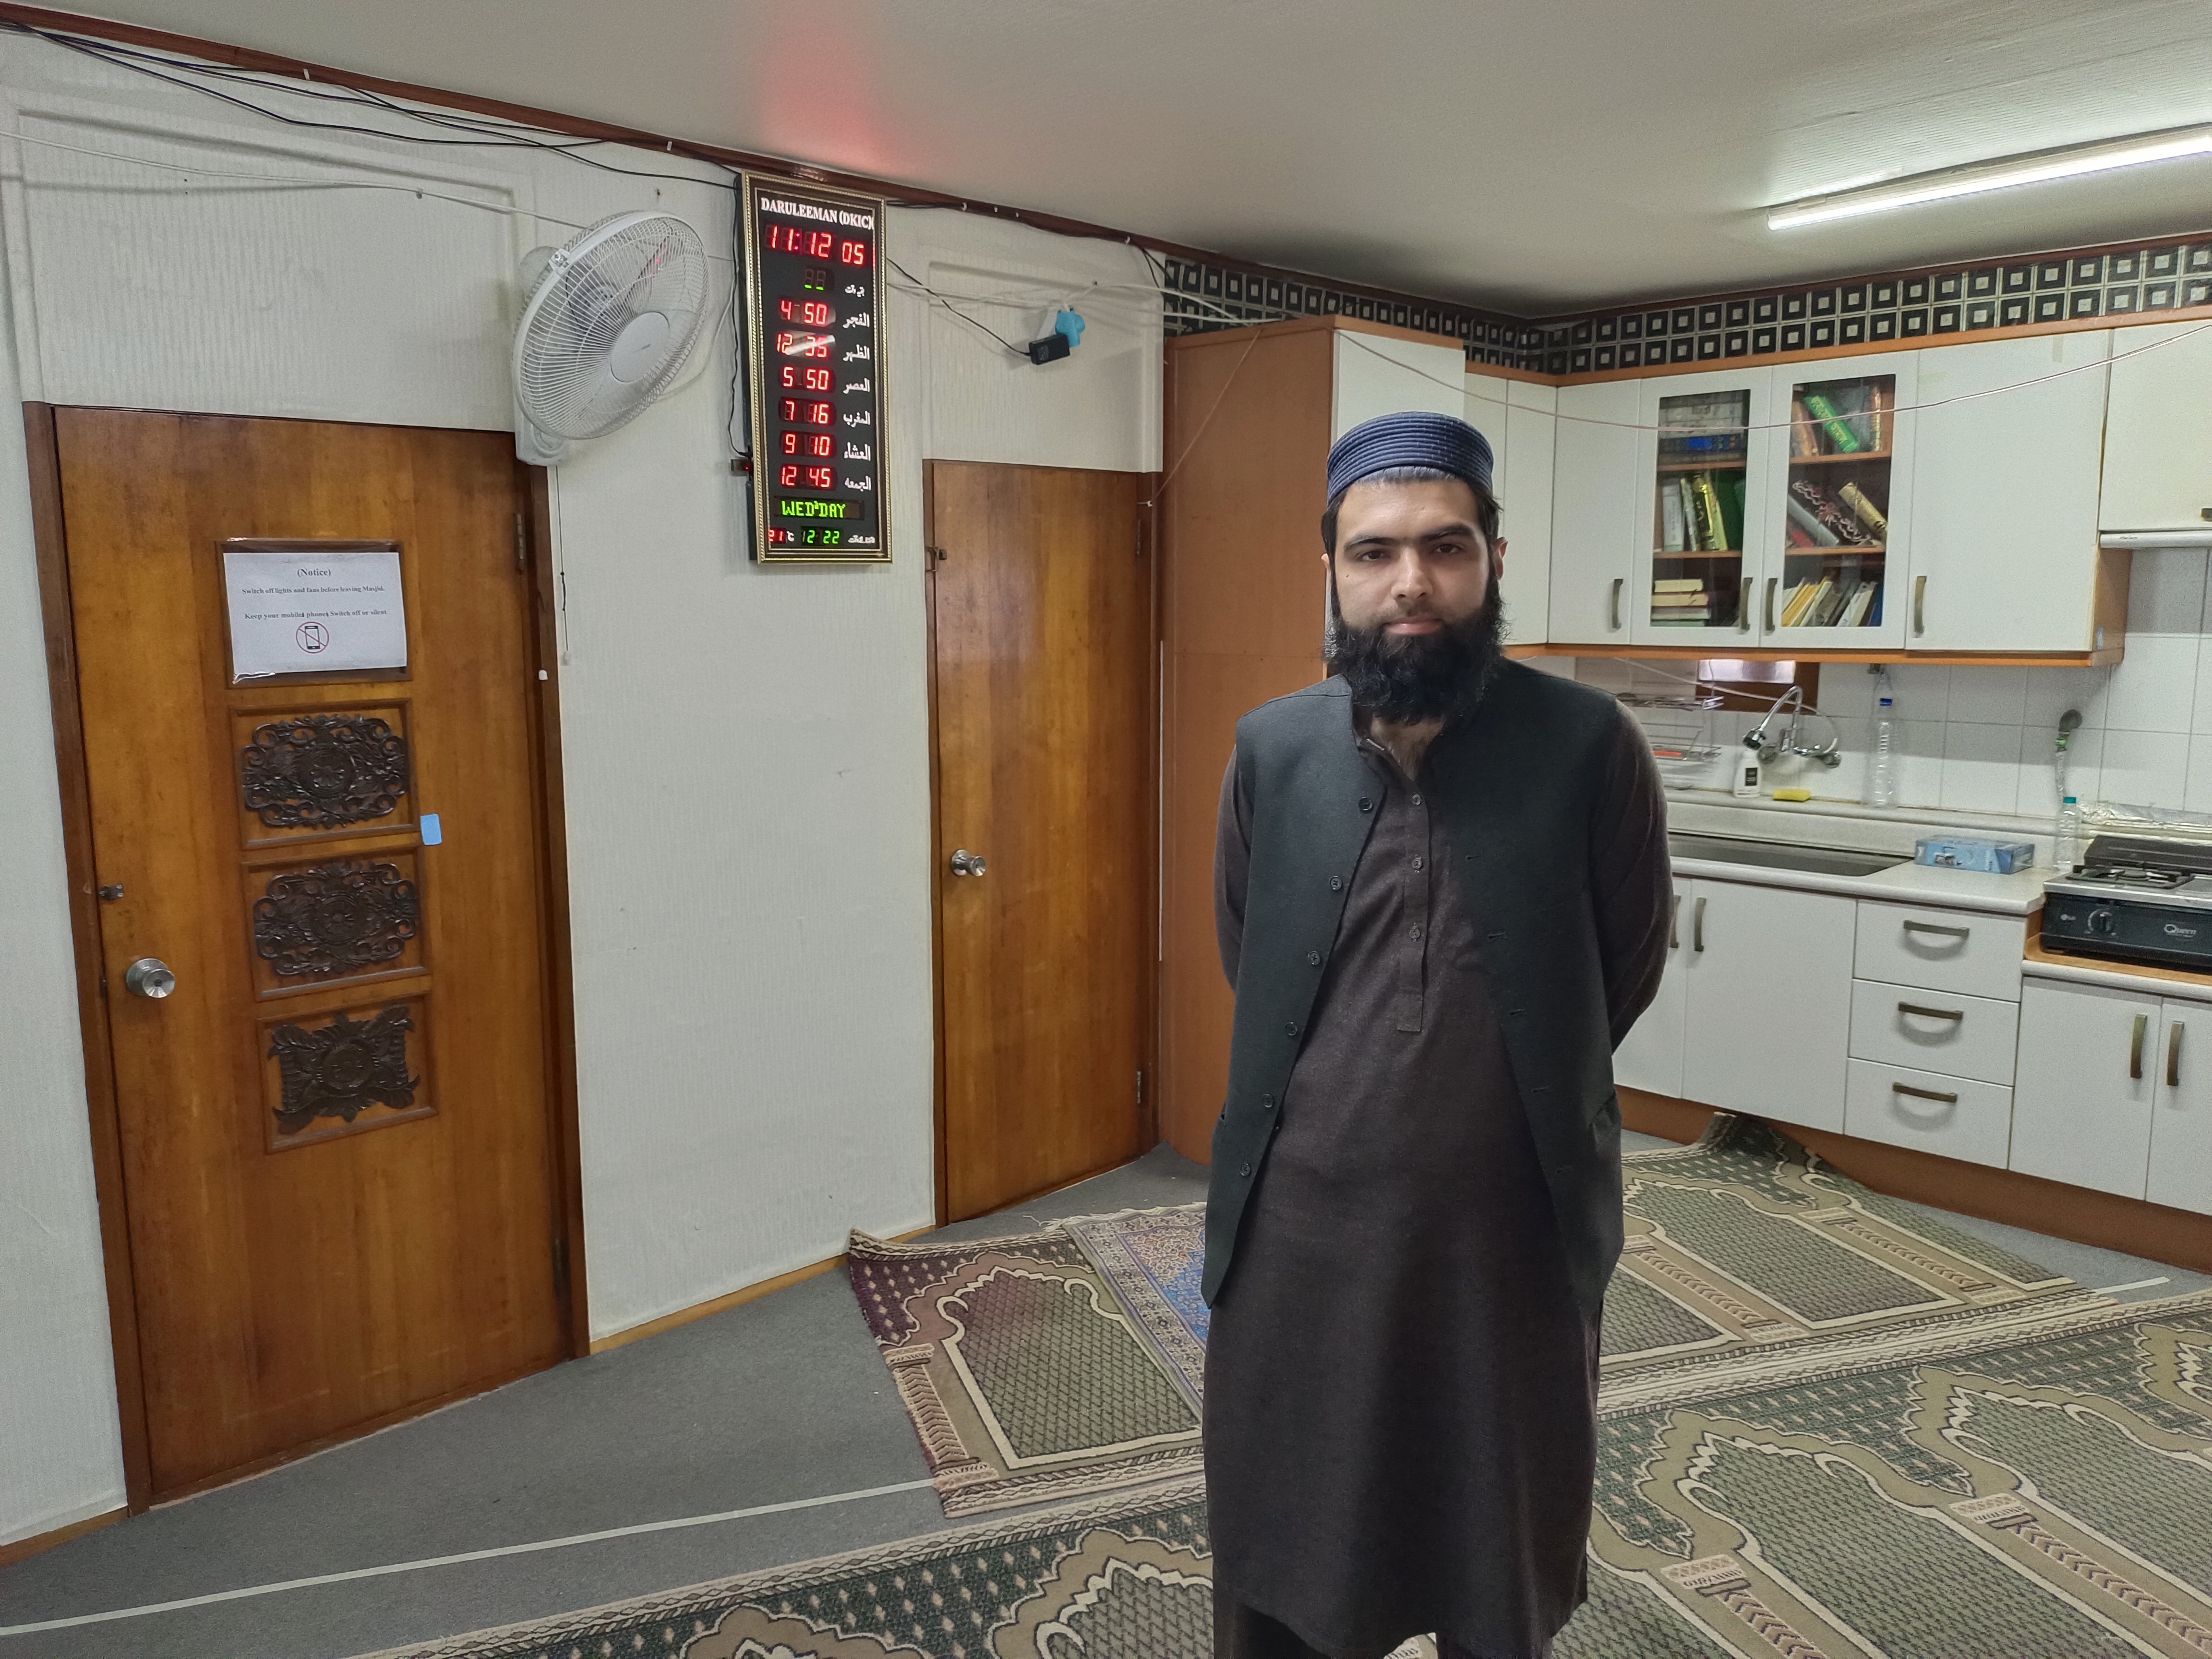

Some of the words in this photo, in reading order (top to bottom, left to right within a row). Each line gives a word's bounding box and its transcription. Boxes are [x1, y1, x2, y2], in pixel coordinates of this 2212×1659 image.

[761, 197, 838, 223] DARULEEMAN
[839, 210, 872, 229] (DKIC)
[772, 226, 831, 258] 11:12
[842, 242, 864, 264] 05
[781, 301, 792, 320] 4
[804, 303, 827, 325] 50
[842, 312, 870, 328] الفجر
[777, 333, 793, 354] 12
[783, 367, 793, 387] 5
[806, 369, 829, 390] 50
[843, 378, 870, 394] العصر
[785, 401, 795, 421] 7
[812, 404, 830, 424] 16
[785, 433, 796, 454] 9
[814, 436, 830, 456] 10
[781, 466, 797, 486] 12
[809, 468, 830, 488] 45
[823, 530, 840, 544] 22
[297, 568, 331, 577] (Notice)
